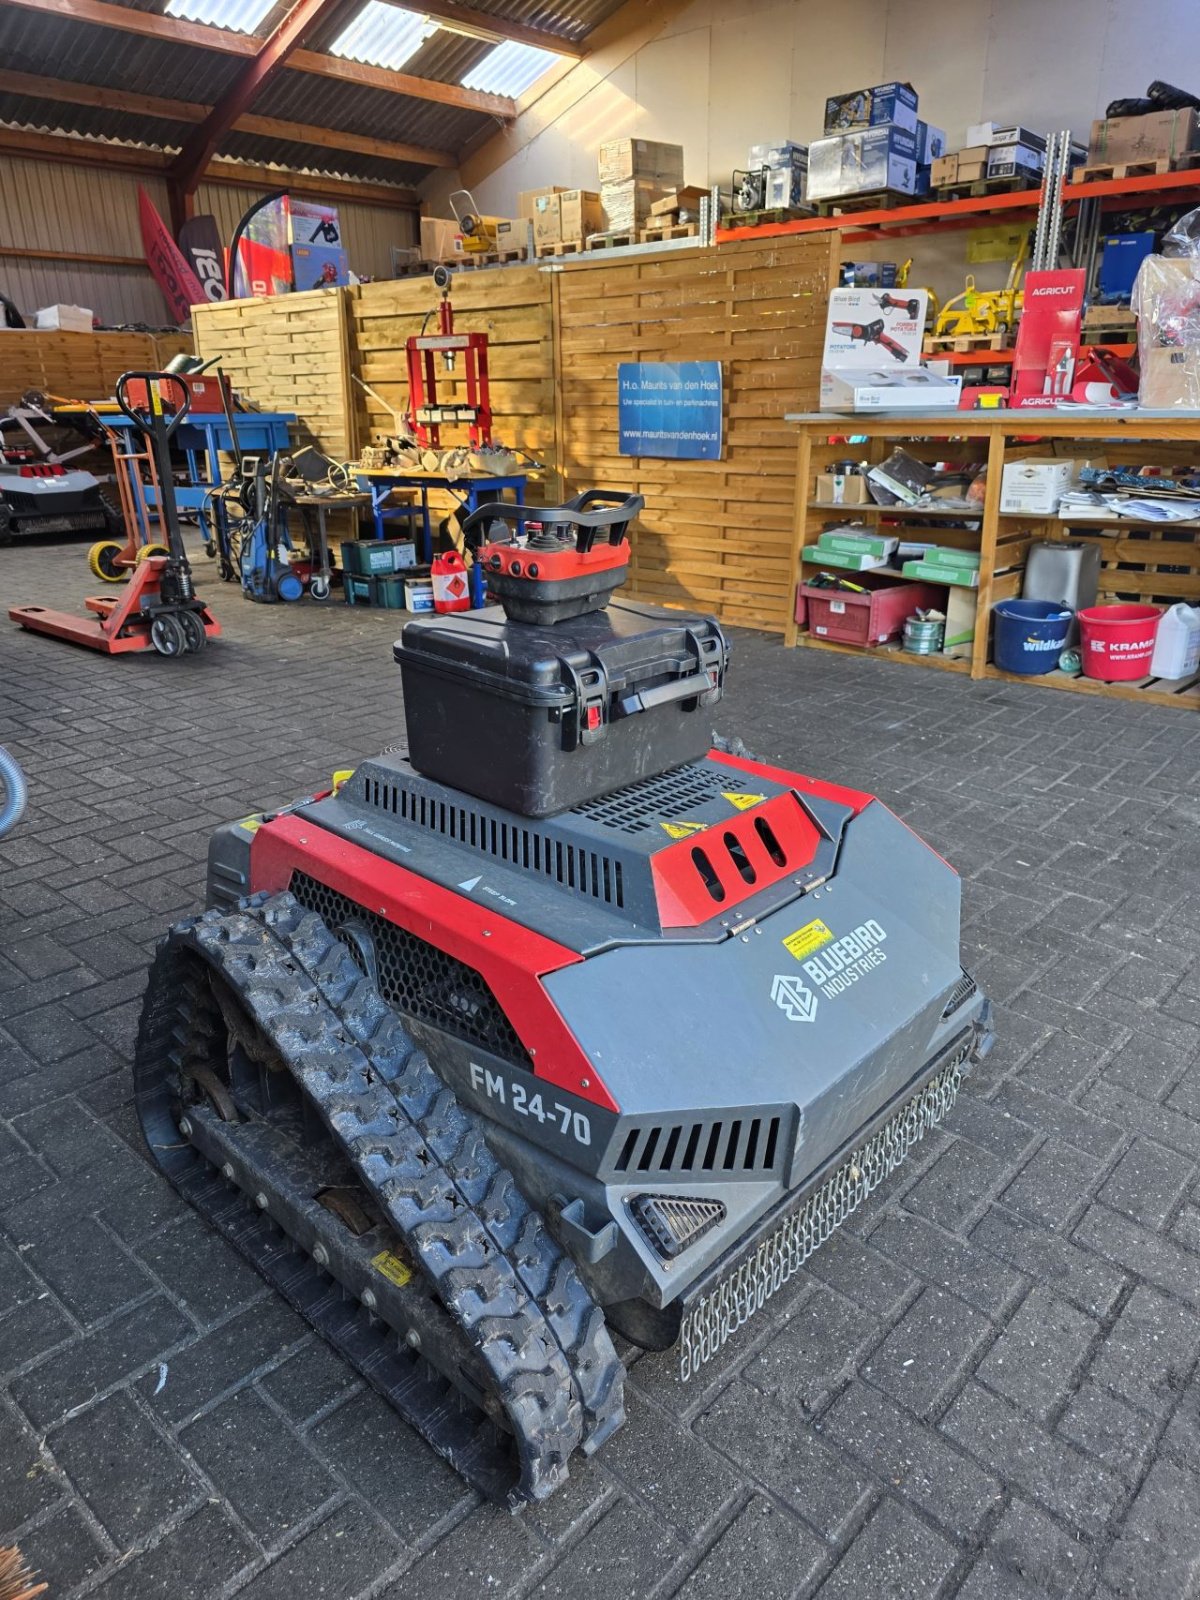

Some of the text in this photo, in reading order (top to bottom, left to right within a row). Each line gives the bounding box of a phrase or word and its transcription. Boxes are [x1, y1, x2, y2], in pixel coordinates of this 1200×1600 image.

[1032, 286, 1075, 296] AGRICUT
[669, 382, 682, 390] van
[685, 381, 698, 390] den
[701, 380, 718, 390] Hoek
[622, 430, 718, 440] www.mauritsvandenhoek.nl
[1110, 639, 1154, 651] KRAMP
[802, 919, 887, 985] BLUEBIRD
[820, 947, 887, 1000] INDUSTRIES
[469, 1062, 592, 1146] FM 24-70
